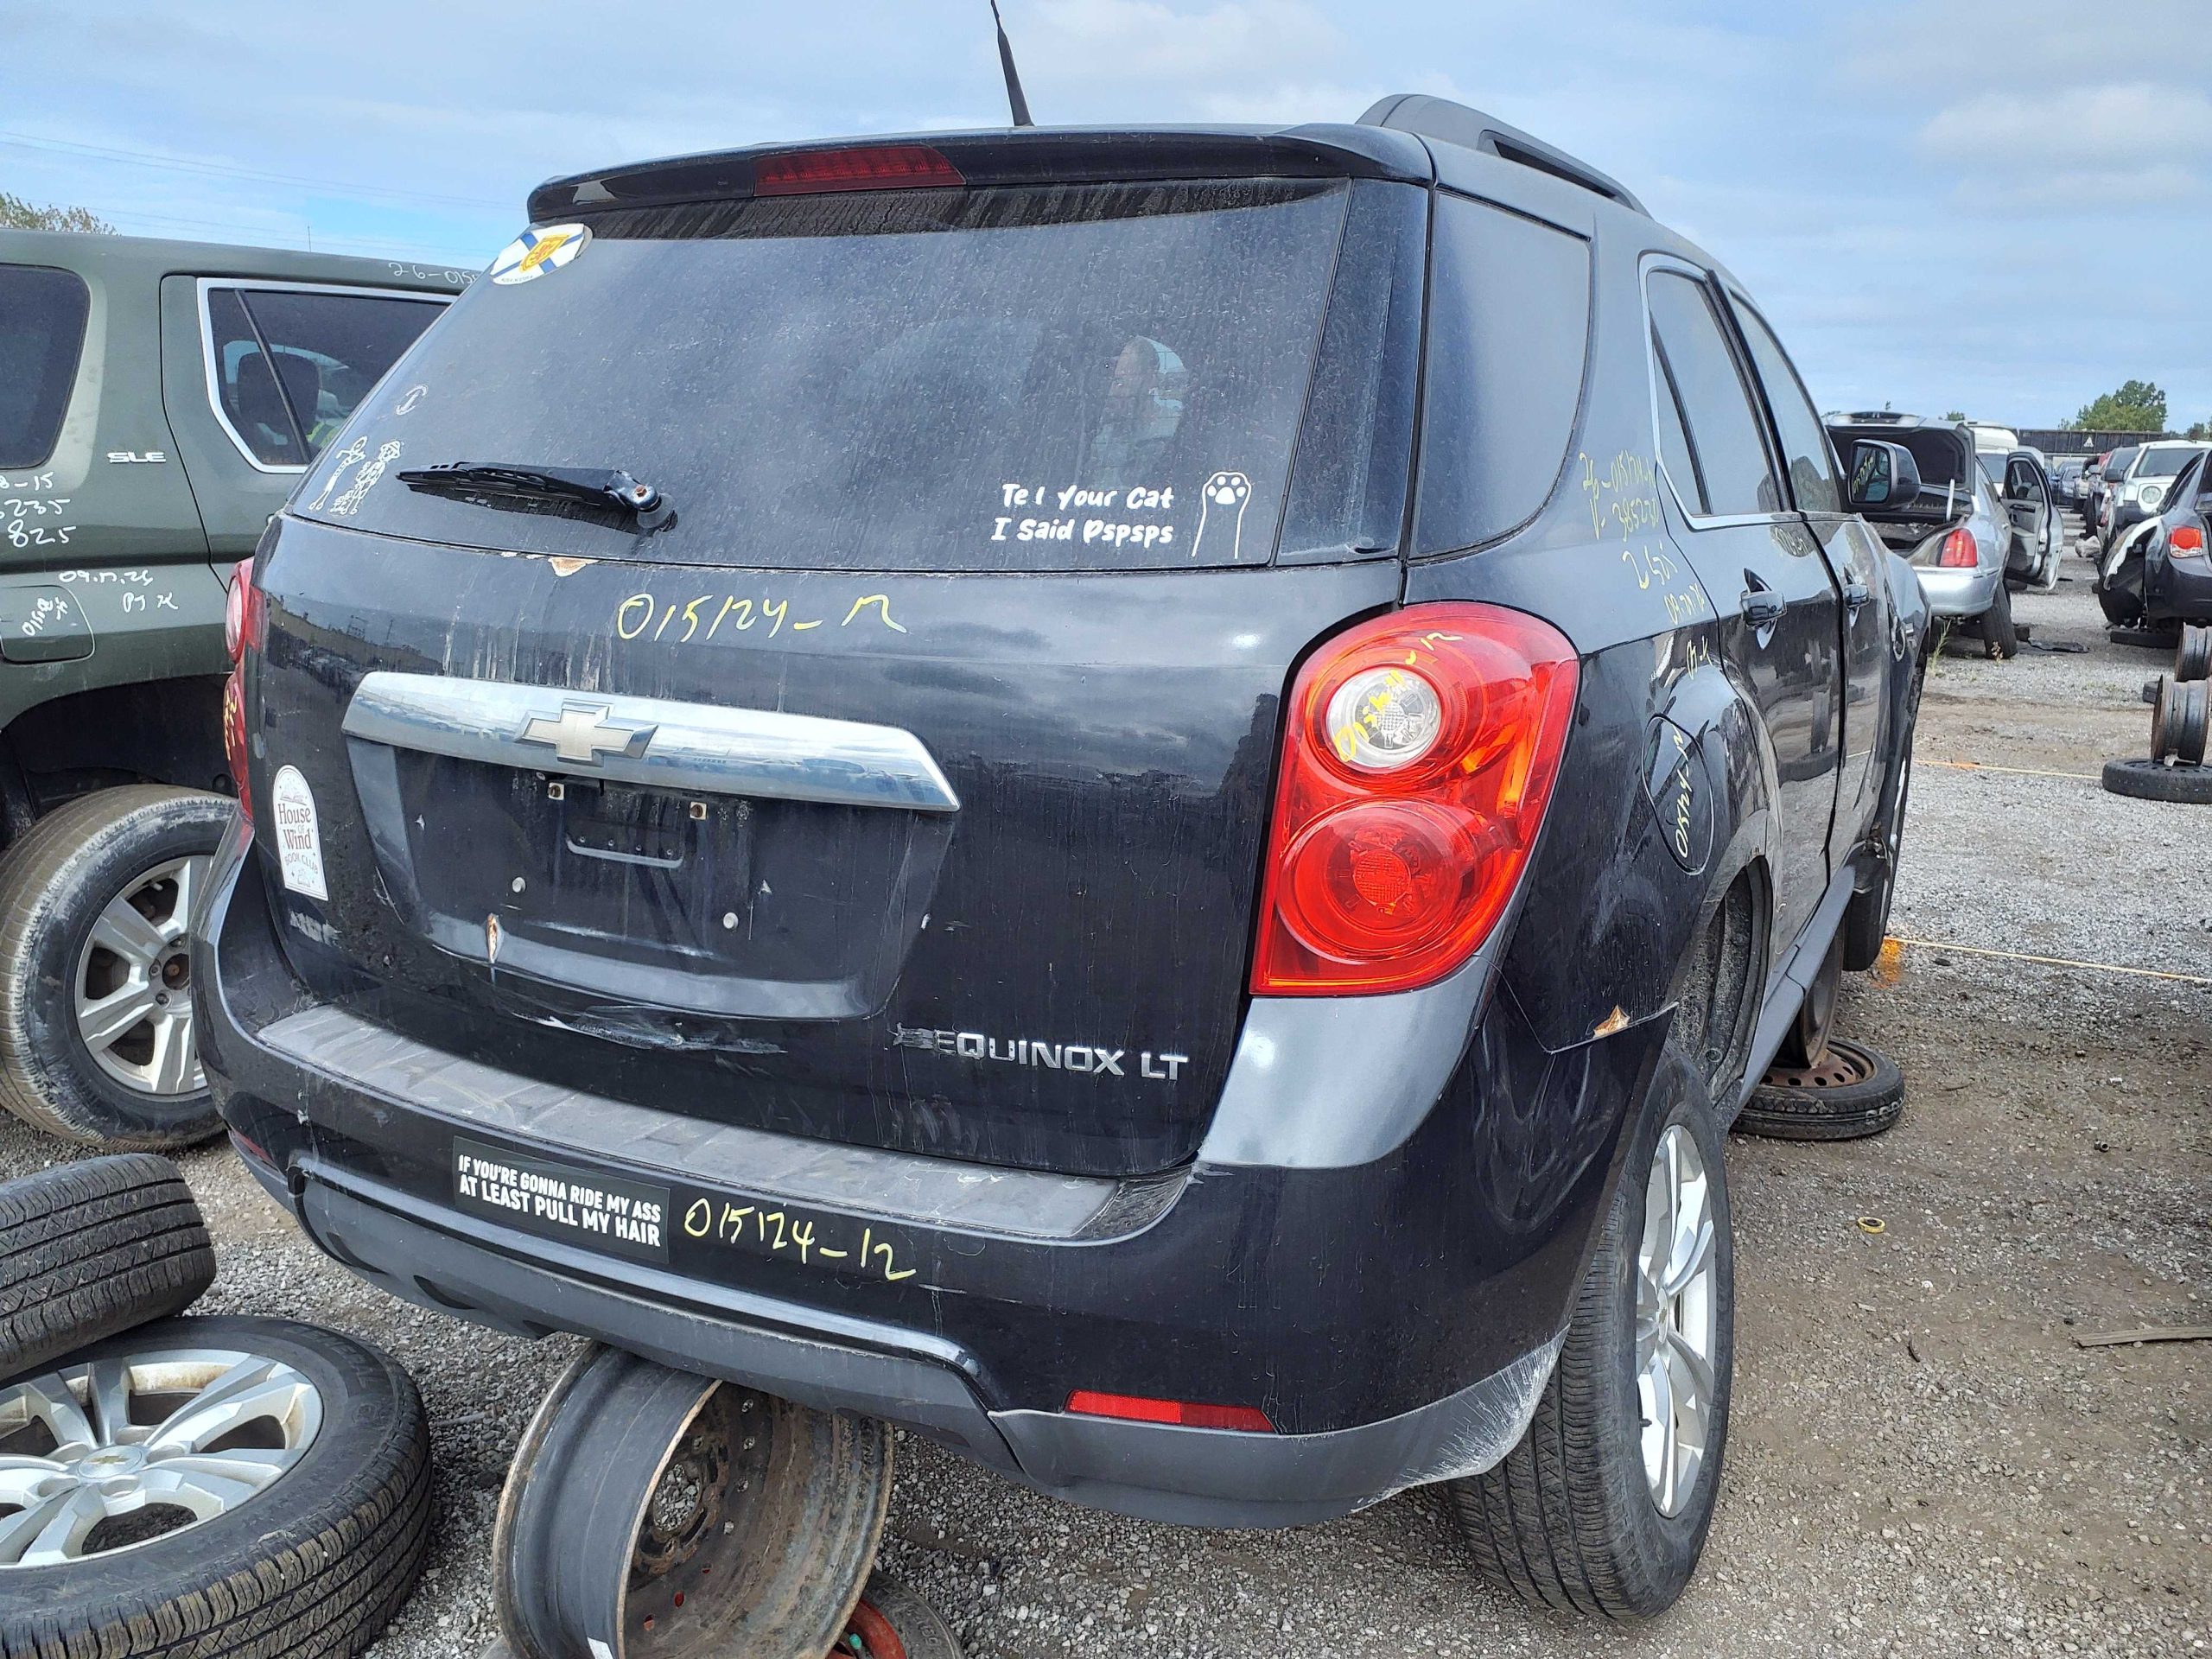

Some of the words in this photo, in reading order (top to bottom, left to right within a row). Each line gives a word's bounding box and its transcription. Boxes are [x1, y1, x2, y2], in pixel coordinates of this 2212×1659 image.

[107, 452, 167, 463] SLE
[1126, 486, 1174, 510] Cat
[7, 519, 77, 548] 825
[990, 517, 1012, 541] I
[1016, 518, 1076, 541] Said
[1083, 519, 1174, 549] Pspsps
[277, 803, 312, 824] House
[283, 827, 312, 850] Wind
[301, 854, 319, 874] CLUB
[1141, 1052, 1189, 1081] LT
[458, 1154, 471, 1172] IF
[474, 1158, 518, 1187] YOU'RE
[520, 1172, 566, 1200] GONNA
[570, 1184, 603, 1209] RIDE
[607, 1194, 630, 1215] MY
[632, 1200, 661, 1223] ASS
[459, 1174, 477, 1197] AT
[481, 1180, 530, 1212] LEAST
[535, 1196, 578, 1227] PULL
[582, 1208, 610, 1234] MY
[615, 1217, 660, 1247] HAIR
